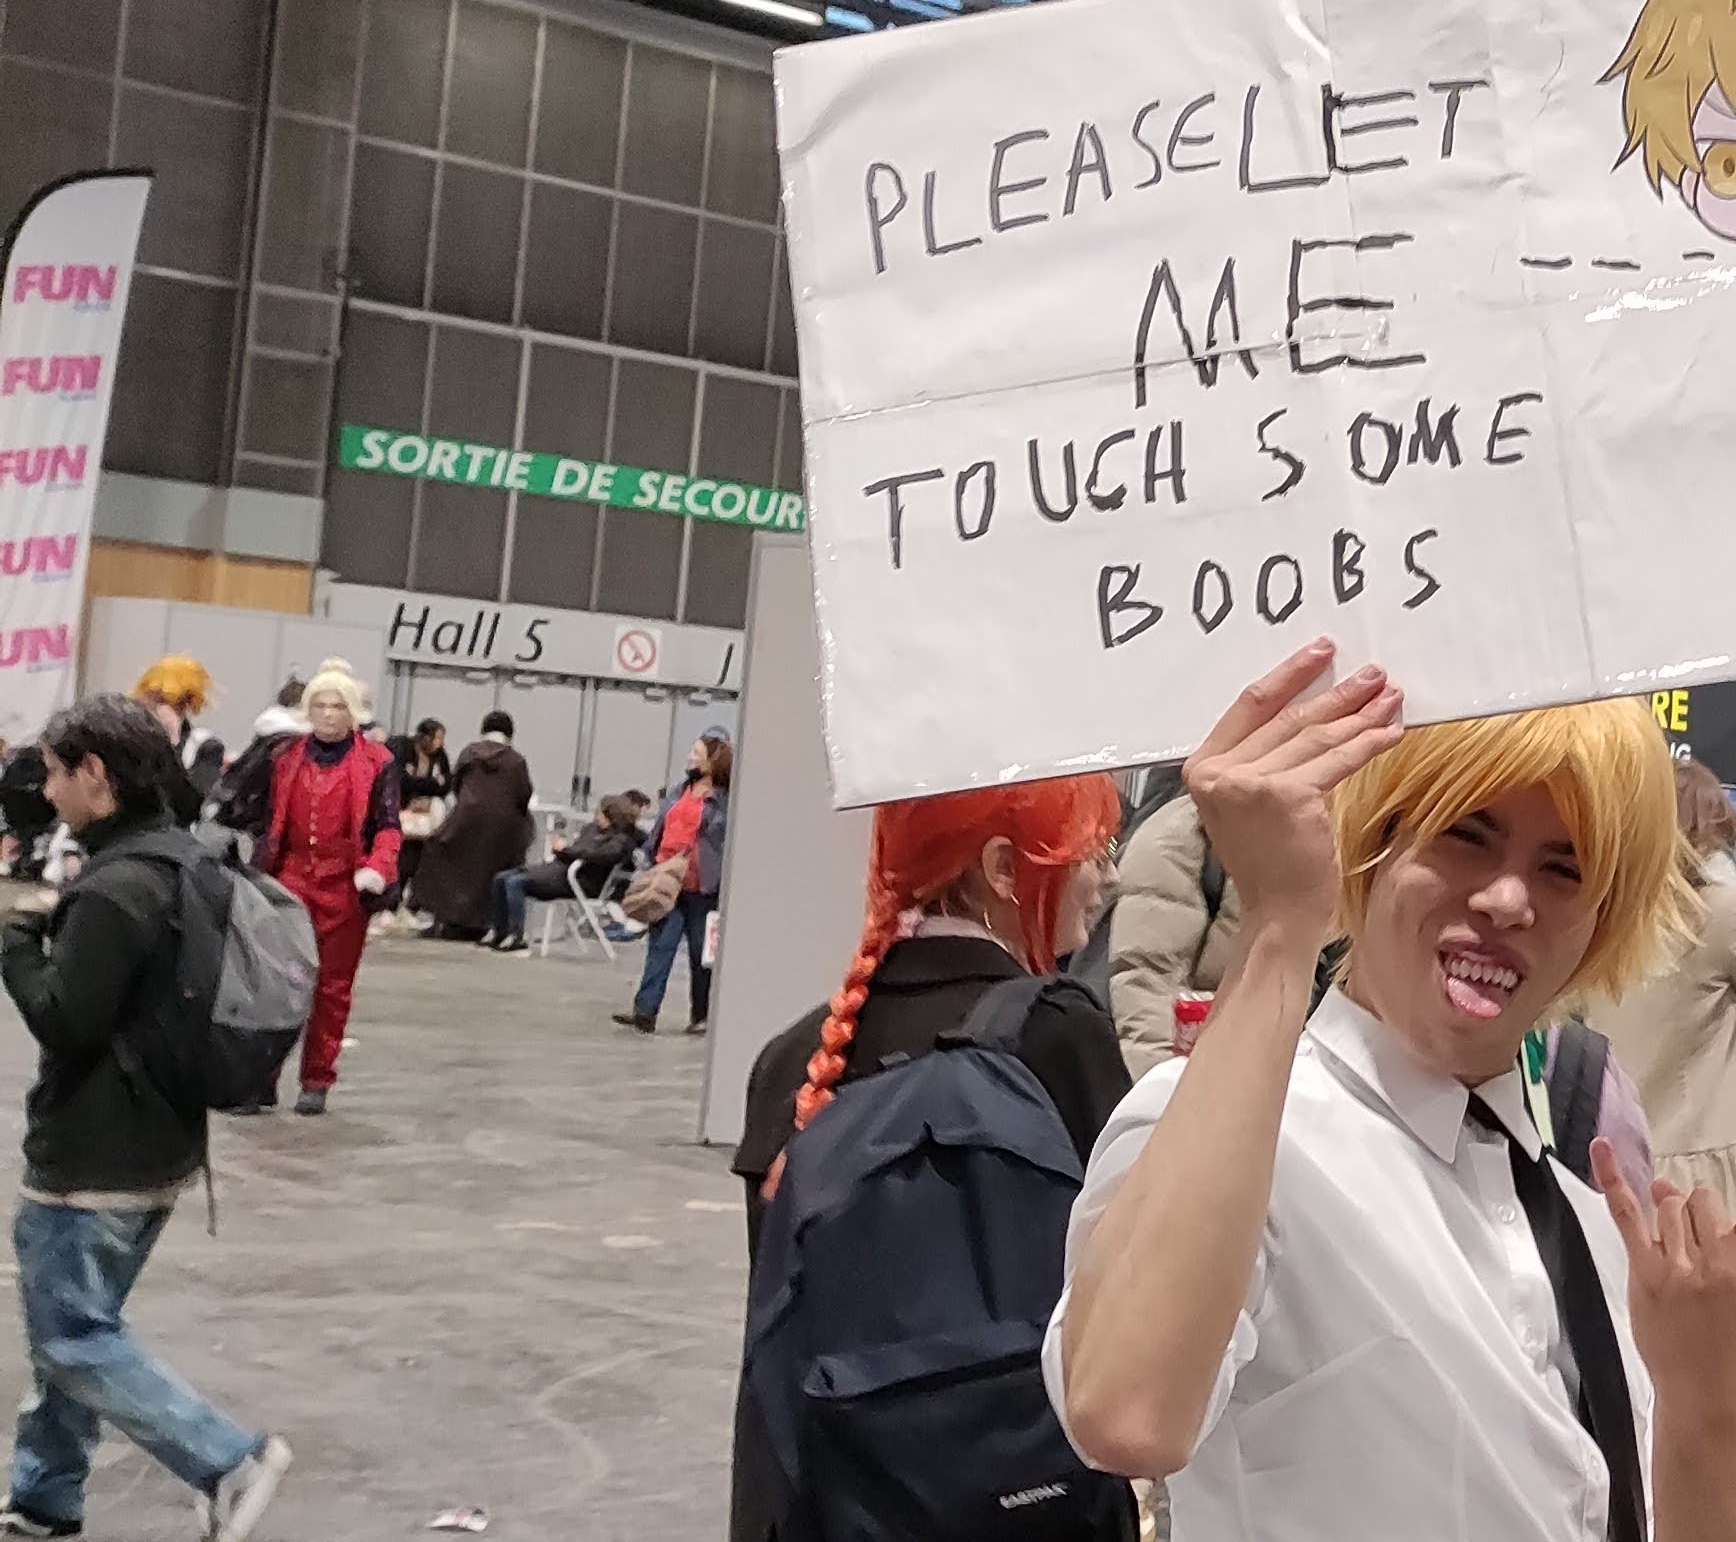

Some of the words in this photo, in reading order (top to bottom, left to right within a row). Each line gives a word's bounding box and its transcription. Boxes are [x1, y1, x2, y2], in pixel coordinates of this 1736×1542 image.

[13, 264, 118, 303] FUN
[1134, 234, 1426, 408] ME
[2, 354, 102, 396] FUN
[356, 428, 534, 490] SORTIE
[551, 458, 617, 501] DE
[632, 471, 804, 529] SECOUR
[863, 419, 1187, 570] TOUCH
[1257, 393, 1543, 503] SOME
[0, 533, 77, 576] UN
[1096, 529, 1442, 649] BOOBS
[0, 624, 70, 667] UN
[388, 602, 501, 659] Hall
[514, 618, 550, 663] 5
